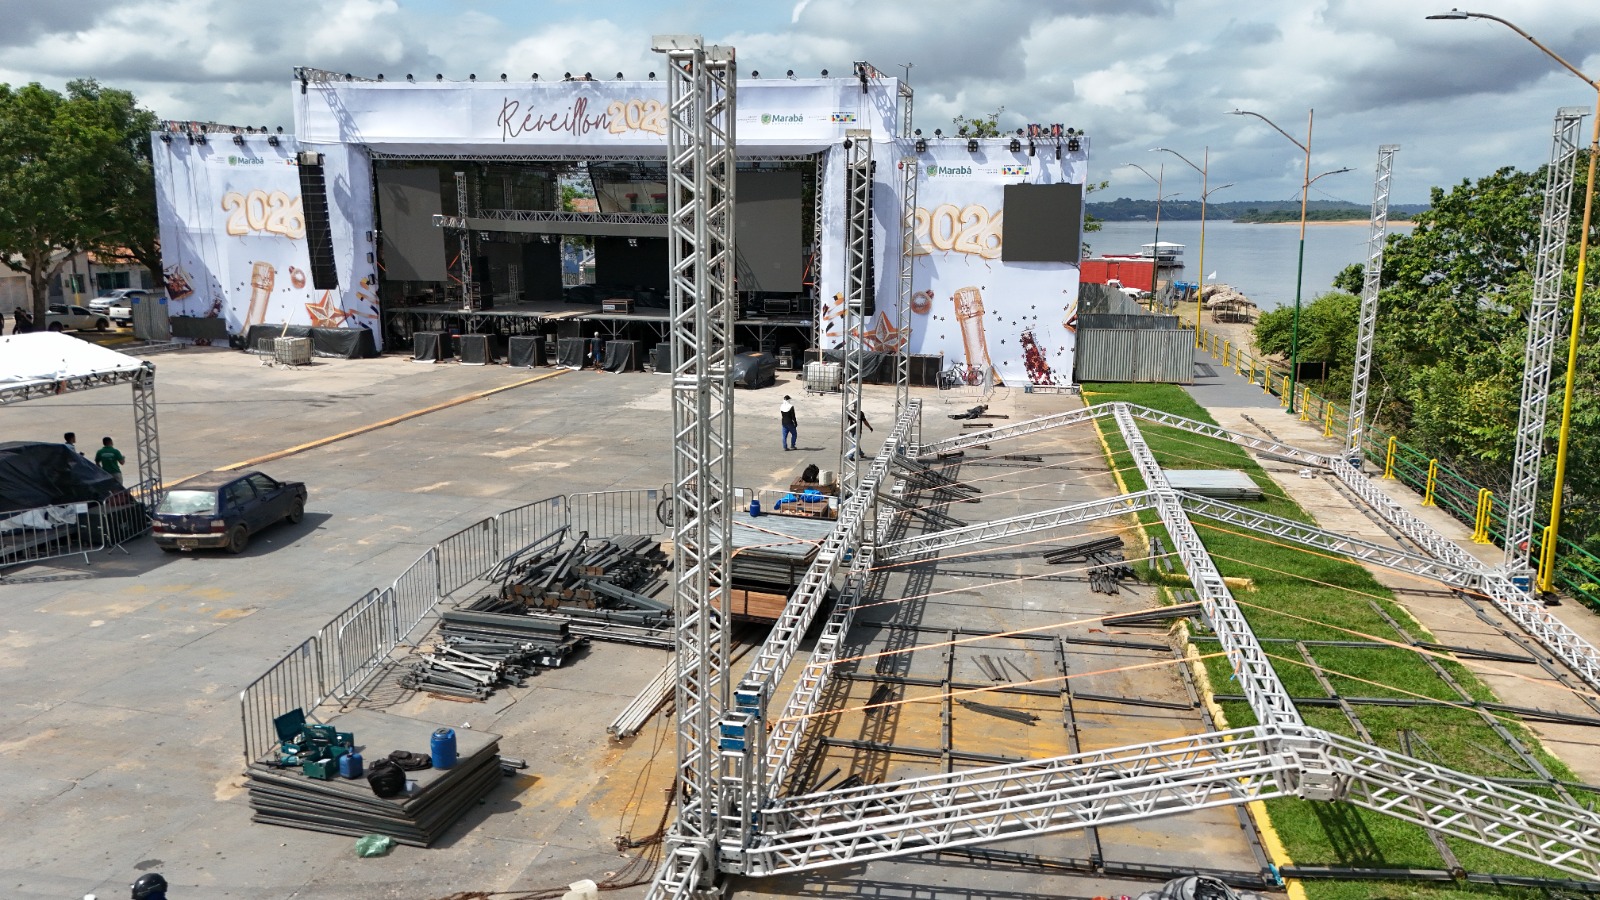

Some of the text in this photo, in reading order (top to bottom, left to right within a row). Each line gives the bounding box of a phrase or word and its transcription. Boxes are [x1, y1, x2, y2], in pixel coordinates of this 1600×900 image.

[498, 97, 611, 142] Réveillon
[772, 113, 804, 122] Marabá
[238, 156, 264, 165] Marabá
[939, 165, 972, 175] Marabá
[222, 189, 306, 239] 2026
